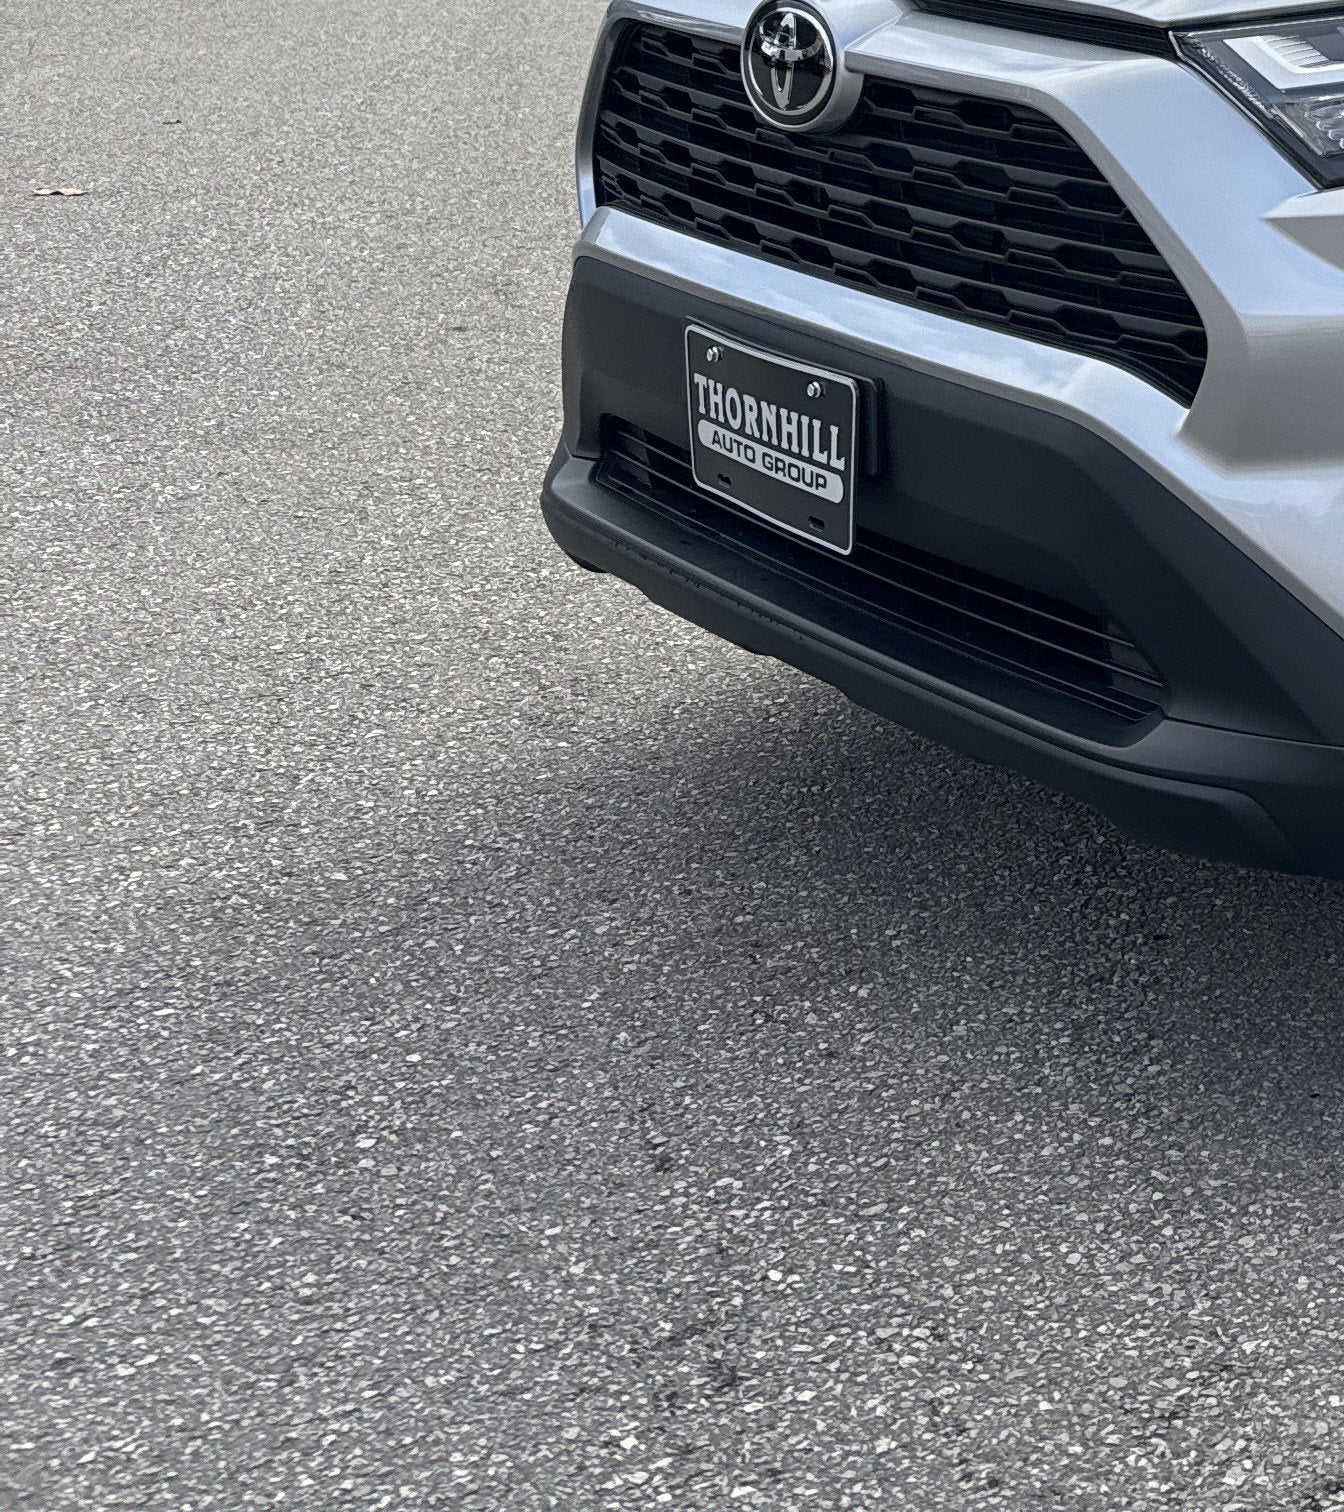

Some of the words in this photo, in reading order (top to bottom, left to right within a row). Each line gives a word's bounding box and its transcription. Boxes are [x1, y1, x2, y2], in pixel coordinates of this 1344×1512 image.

[693, 373, 846, 472] THORNHILL
[711, 430, 756, 464] AUTO
[761, 450, 828, 491] GROUP
